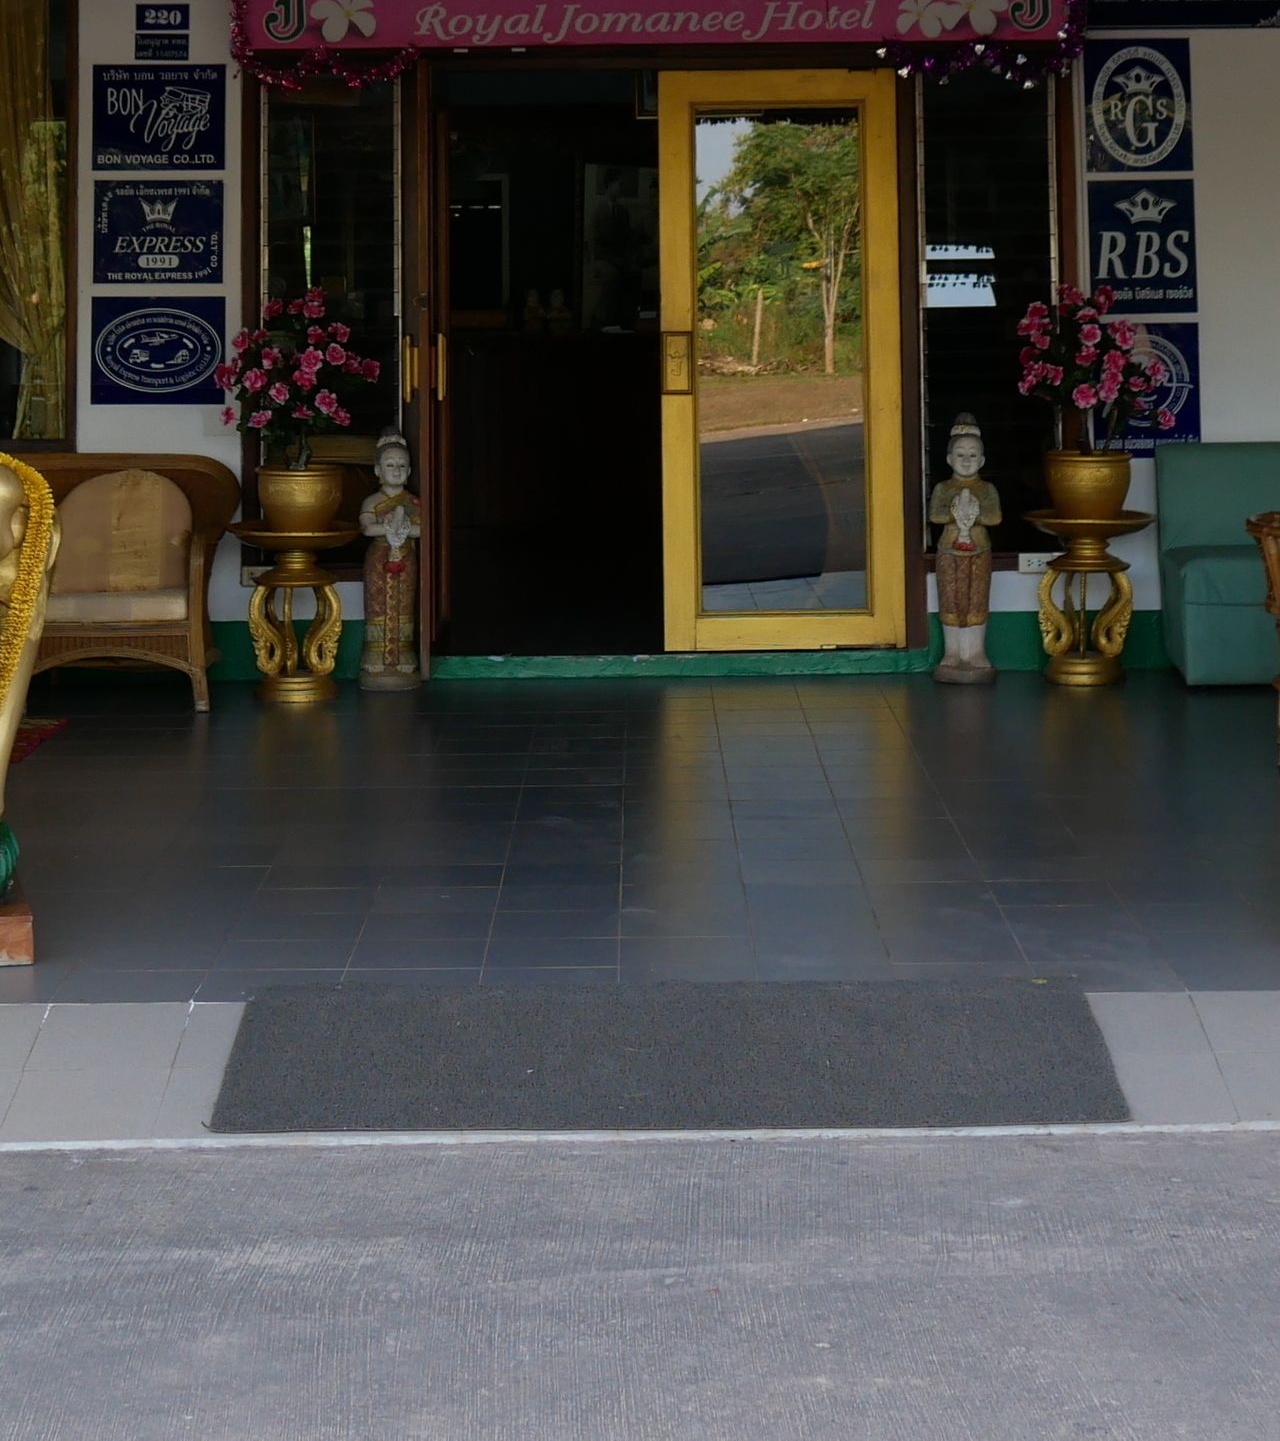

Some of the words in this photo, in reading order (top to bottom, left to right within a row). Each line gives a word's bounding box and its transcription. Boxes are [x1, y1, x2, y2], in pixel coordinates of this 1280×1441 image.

[144, 9, 182, 25] 220
[415, 1, 543, 44] Royal
[542, 4, 746, 42] Jomanee
[742, 0, 874, 41] Hotel
[106, 87, 144, 116] BON
[129, 99, 211, 152] Voyage
[96, 155, 121, 165] BON
[125, 155, 170, 165] VOYAGE
[112, 236, 207, 254] EXPRESS
[145, 256, 173, 266] 1991
[1094, 229, 1190, 280] RBS
[107, 272, 124, 280] THE
[125, 272, 154, 280] ROYAL
[154, 272, 193, 280] EXPRESS
